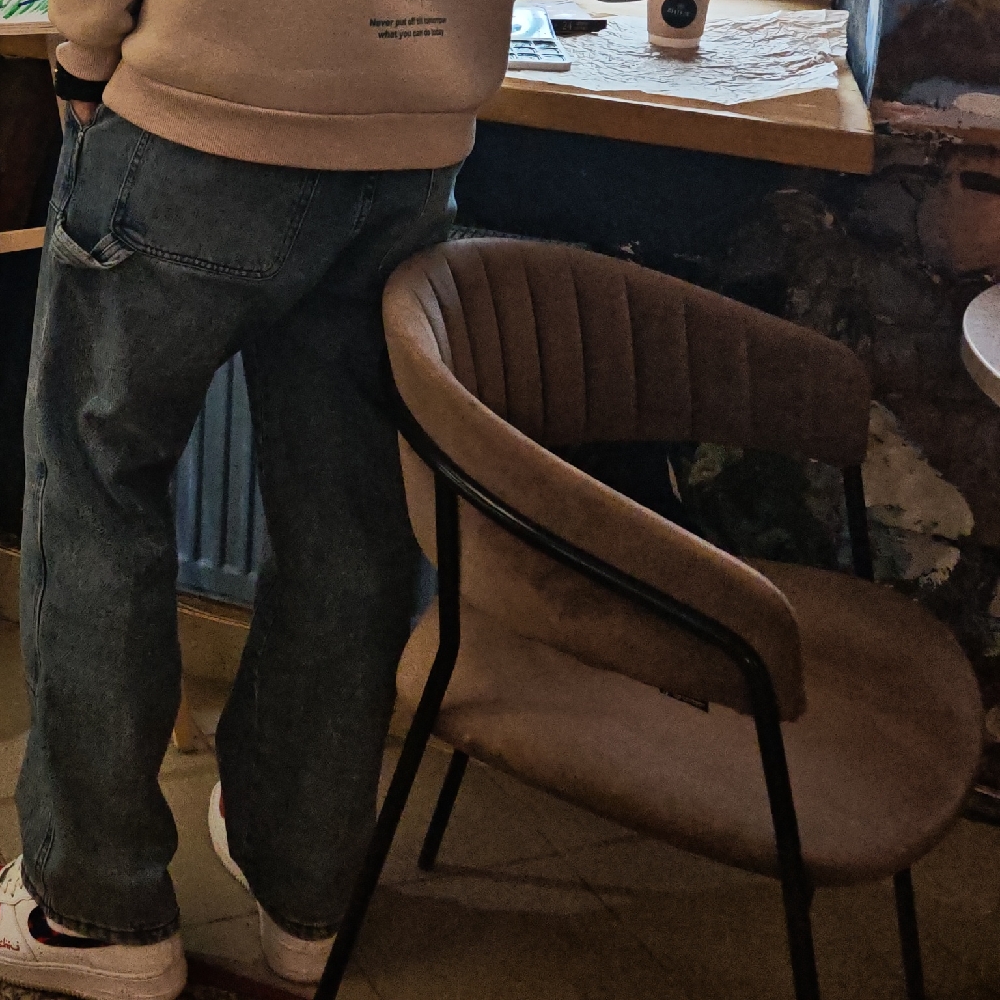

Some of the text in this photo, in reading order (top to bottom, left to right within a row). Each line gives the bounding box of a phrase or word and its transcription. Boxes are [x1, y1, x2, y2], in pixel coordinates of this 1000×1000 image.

[370, 18, 394, 26] Never
[378, 30, 398, 38] what
[399, 30, 411, 40] you
